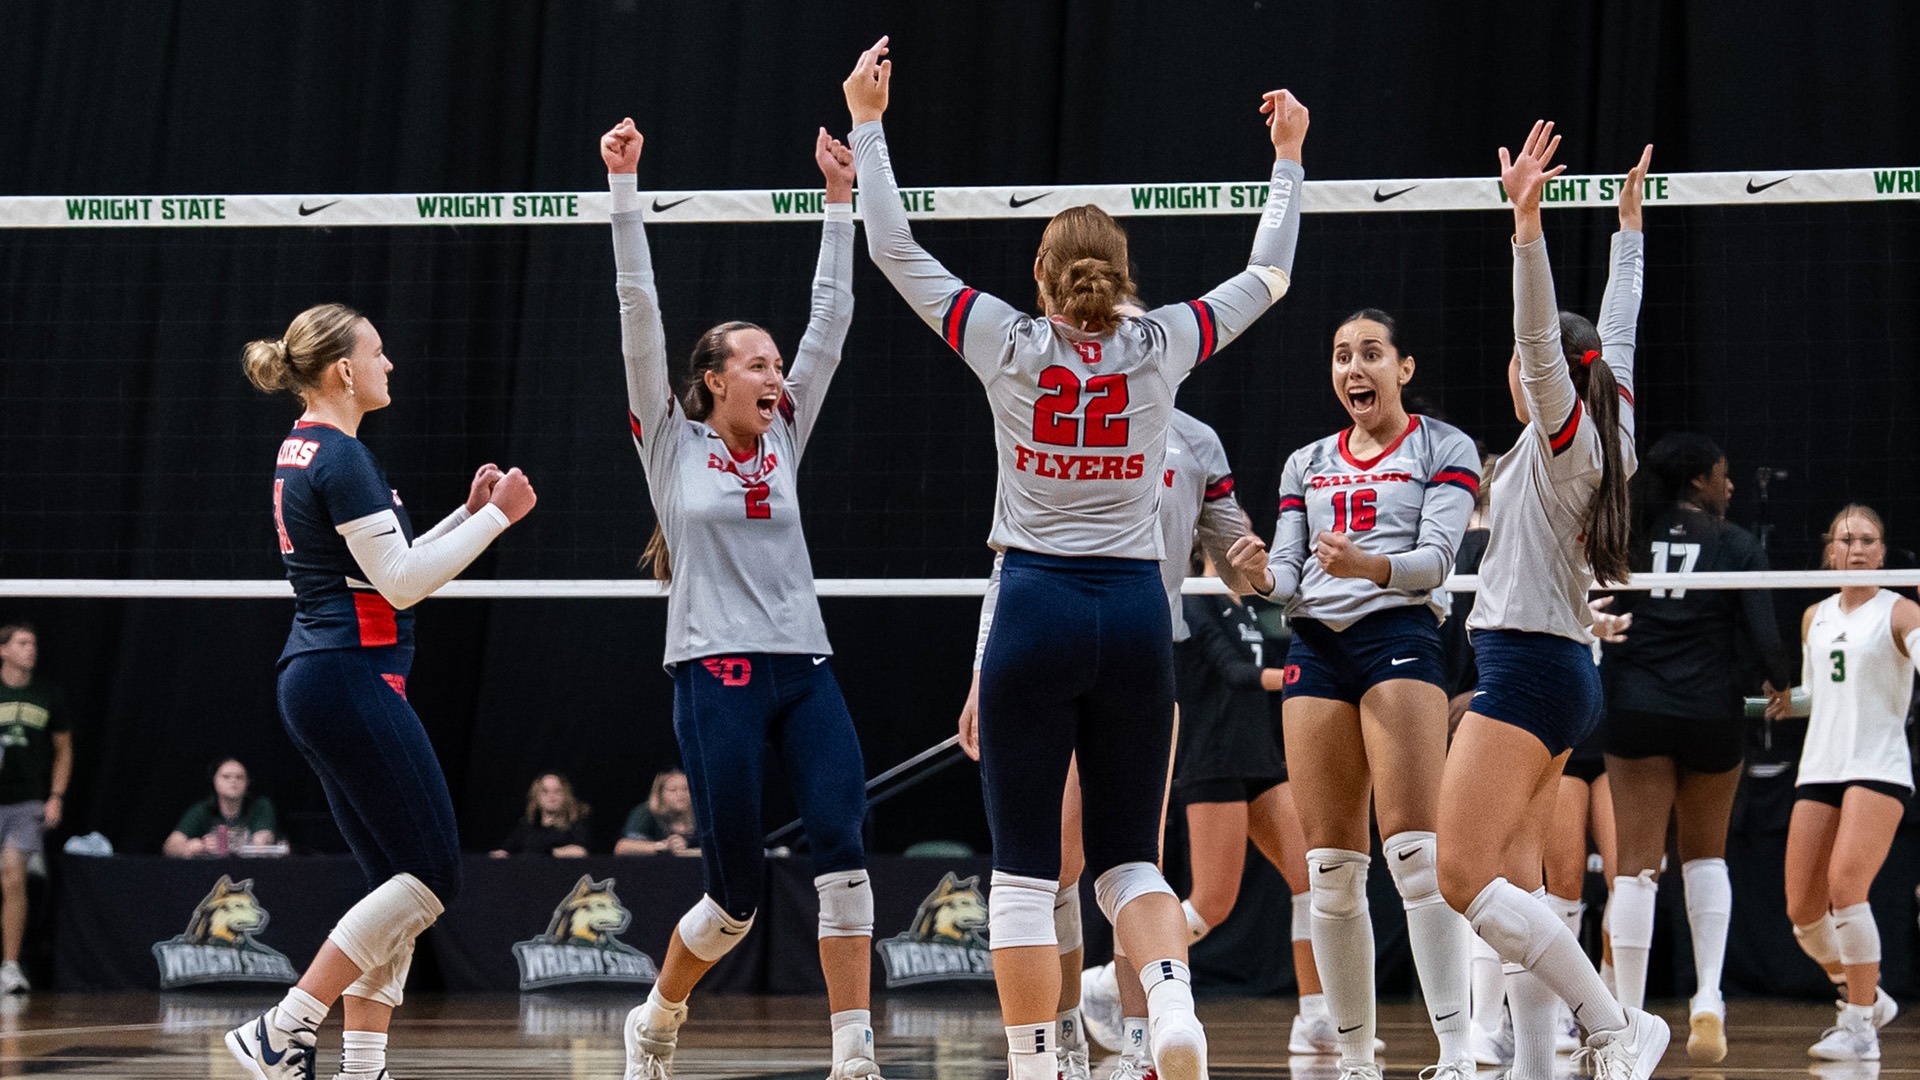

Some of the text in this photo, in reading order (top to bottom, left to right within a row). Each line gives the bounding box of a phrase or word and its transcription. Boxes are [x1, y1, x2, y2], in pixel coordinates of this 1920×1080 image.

[771, 190, 935, 214] WRIGT ATE
[1131, 185, 1270, 209] WRIGHT STA
[1498, 177, 1668, 202] GHT STTE
[66, 198, 226, 220] WRIGHT STATE
[416, 195, 578, 218] WRIGHT STATE
[1032, 364, 1130, 447] 22
[1014, 444, 1145, 481] FLYERS
[742, 480, 772, 520] 2
[1331, 488, 1377, 533] 16
[1651, 541, 1701, 600] 17
[1829, 649, 1846, 682] 3
